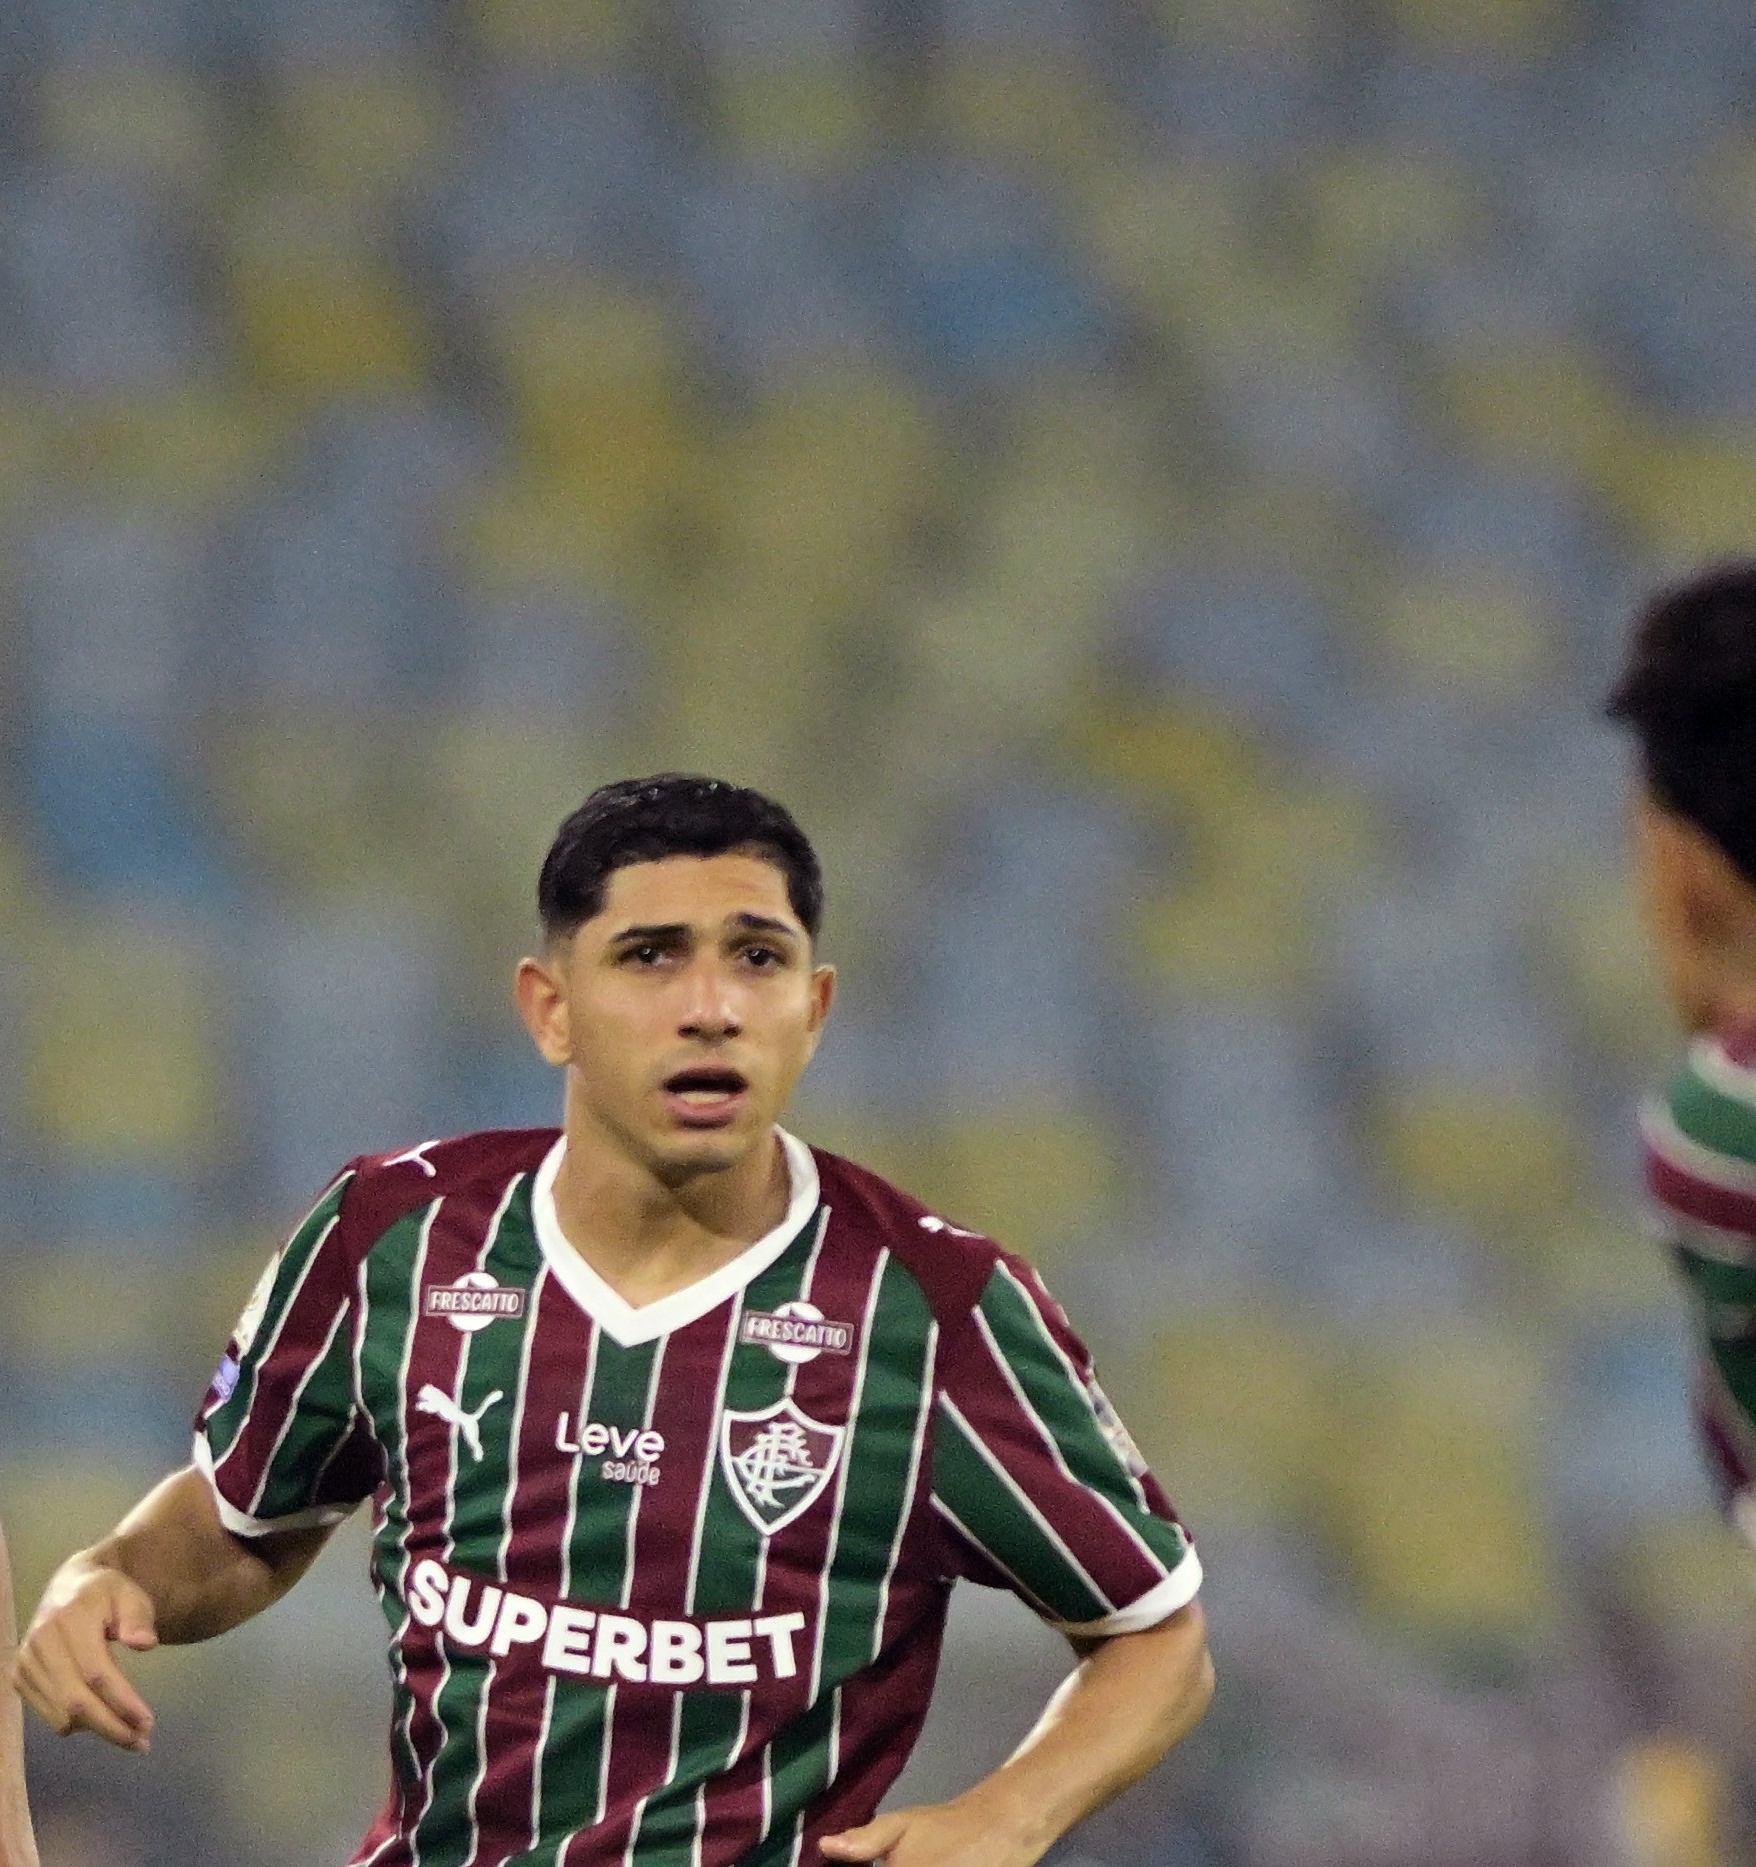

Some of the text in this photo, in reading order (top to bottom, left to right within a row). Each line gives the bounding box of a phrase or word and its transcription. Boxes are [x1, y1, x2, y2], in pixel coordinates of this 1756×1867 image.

[429, 1290, 520, 1313] FRESCATTO
[747, 1316, 847, 1350] FRESCATTO
[555, 1411, 665, 1462] Leve
[601, 1460, 661, 1487] saúde
[405, 1557, 806, 1686] SUPERBET
